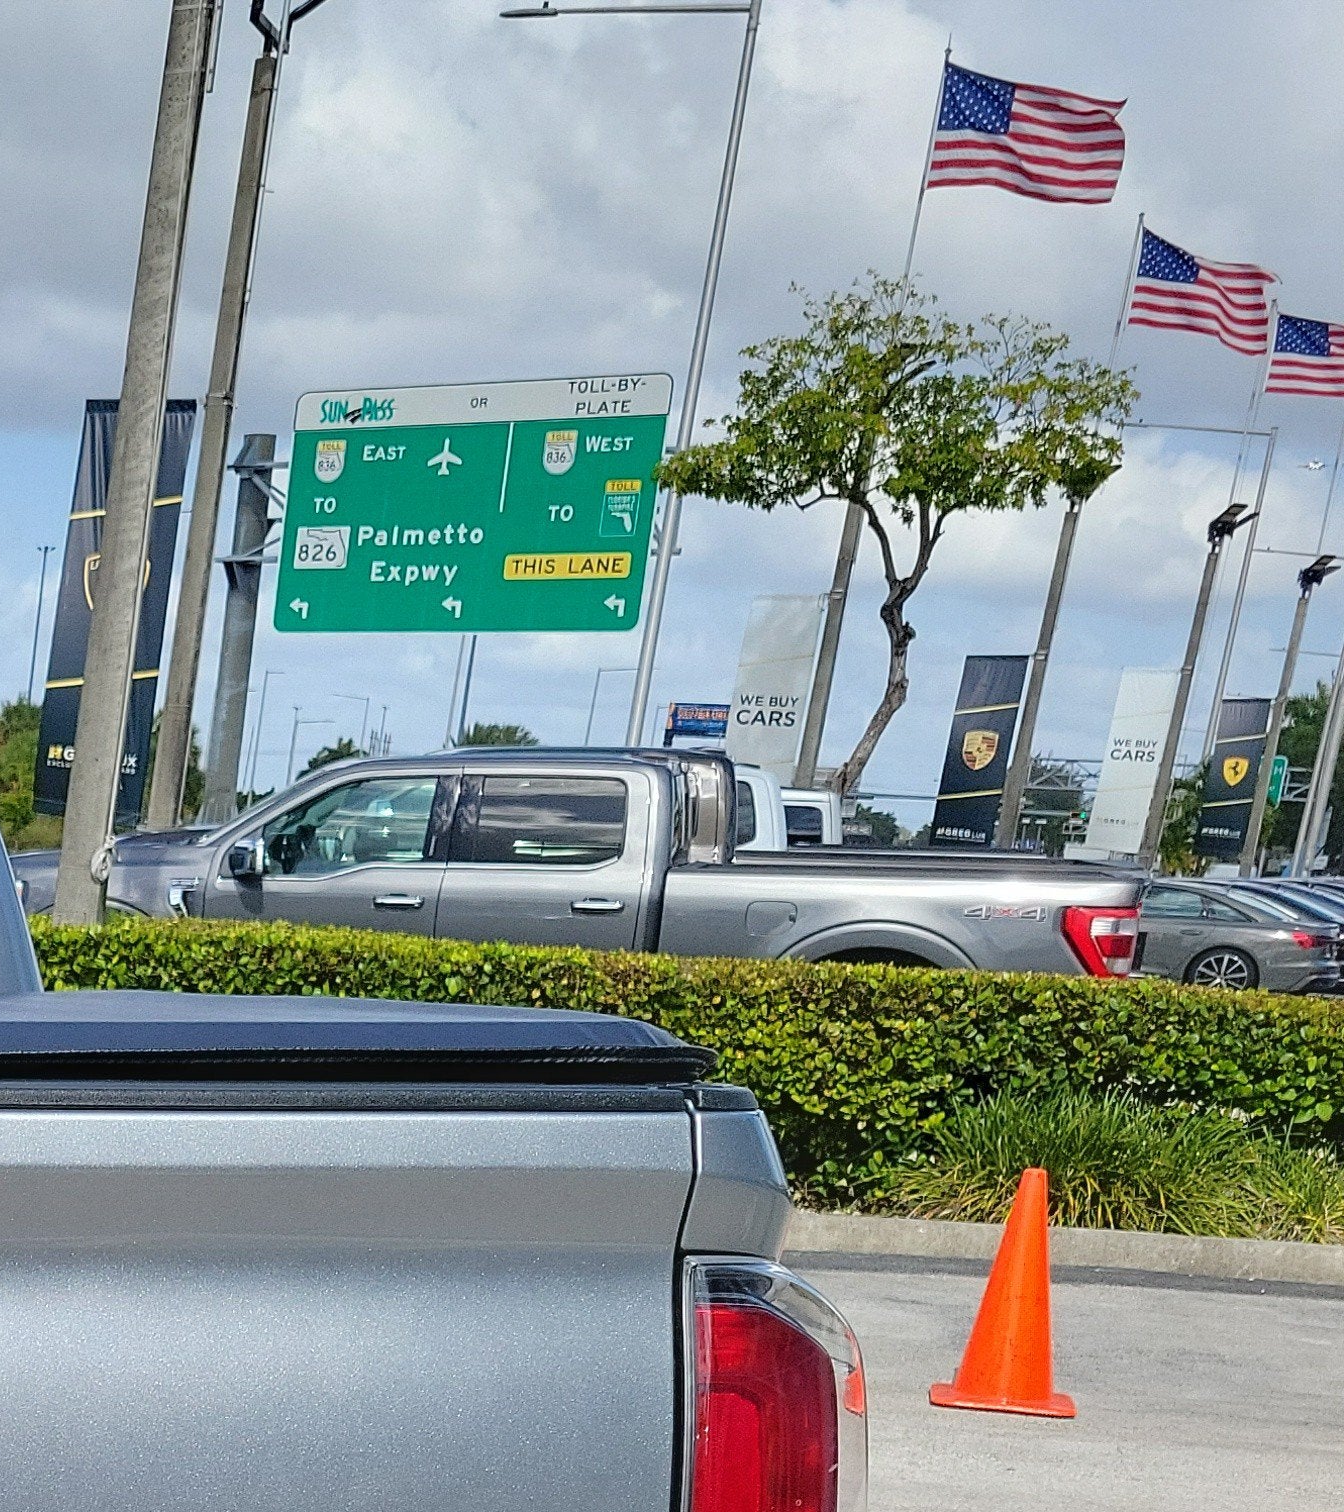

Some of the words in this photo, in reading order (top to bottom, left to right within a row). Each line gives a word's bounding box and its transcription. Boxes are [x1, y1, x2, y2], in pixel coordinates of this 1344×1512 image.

[469, 397, 488, 409] OR
[574, 399, 632, 416] PLATE
[362, 444, 407, 462] EAST
[584, 435, 634, 453] WEST
[545, 450, 567, 464] 836
[313, 497, 337, 514] TO
[548, 504, 574, 522] TO
[357, 523, 485, 548] Palmetto
[297, 544, 337, 563] 826
[369, 560, 458, 586] Expwy
[511, 558, 556, 576] THIS
[568, 557, 625, 575] LANE
[739, 694, 764, 706] WE
[768, 696, 800, 708] BUY
[736, 709, 797, 728] CARS
[1113, 737, 1133, 749] WE
[1135, 738, 1159, 750] BUY
[1109, 748, 1156, 763] CARS
